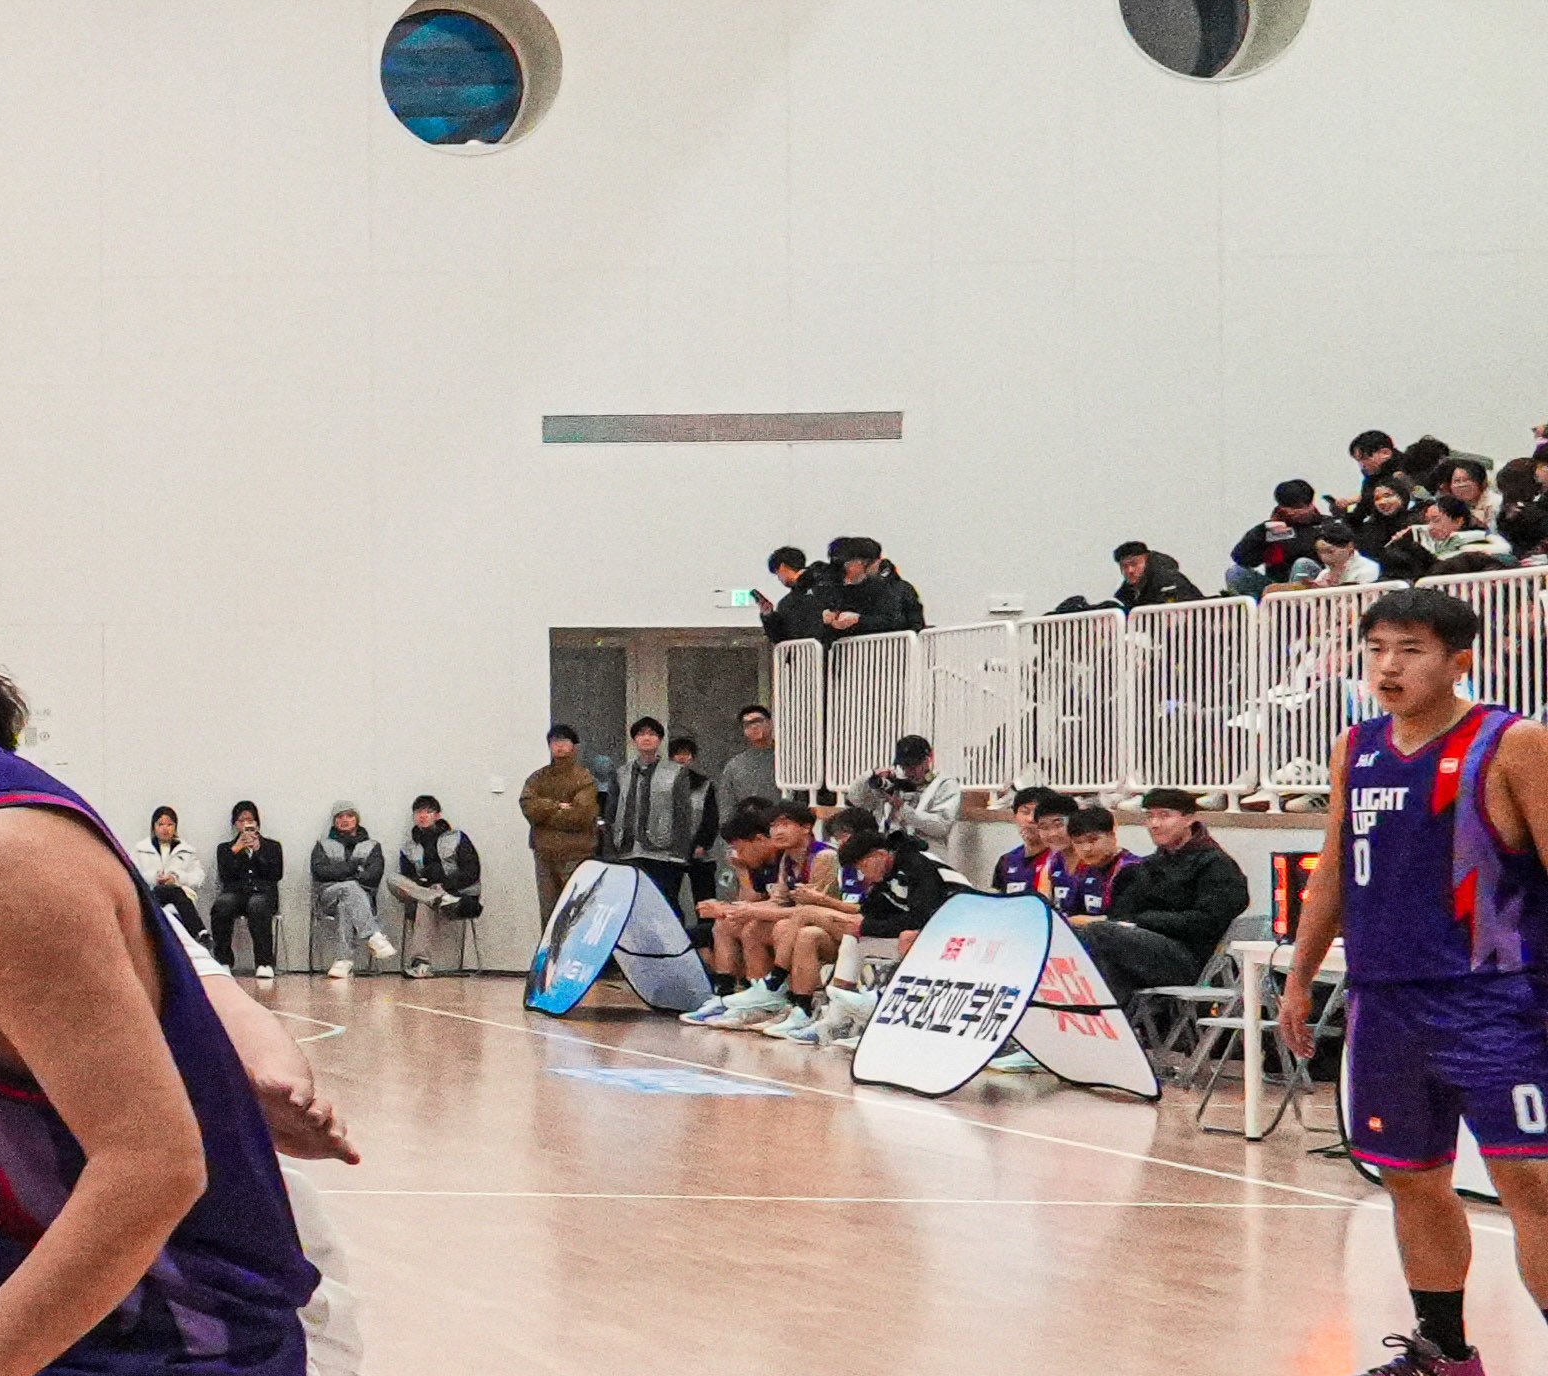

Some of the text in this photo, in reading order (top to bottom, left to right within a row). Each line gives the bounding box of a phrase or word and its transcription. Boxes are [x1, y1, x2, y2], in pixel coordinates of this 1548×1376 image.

[1352, 787, 1409, 811] LIGHT
[1352, 811, 1377, 835] UP
[1353, 838, 1371, 886] 0
[876, 975, 1021, 1042] 西安欧亚学院
[1511, 1084, 1547, 1134] 0
